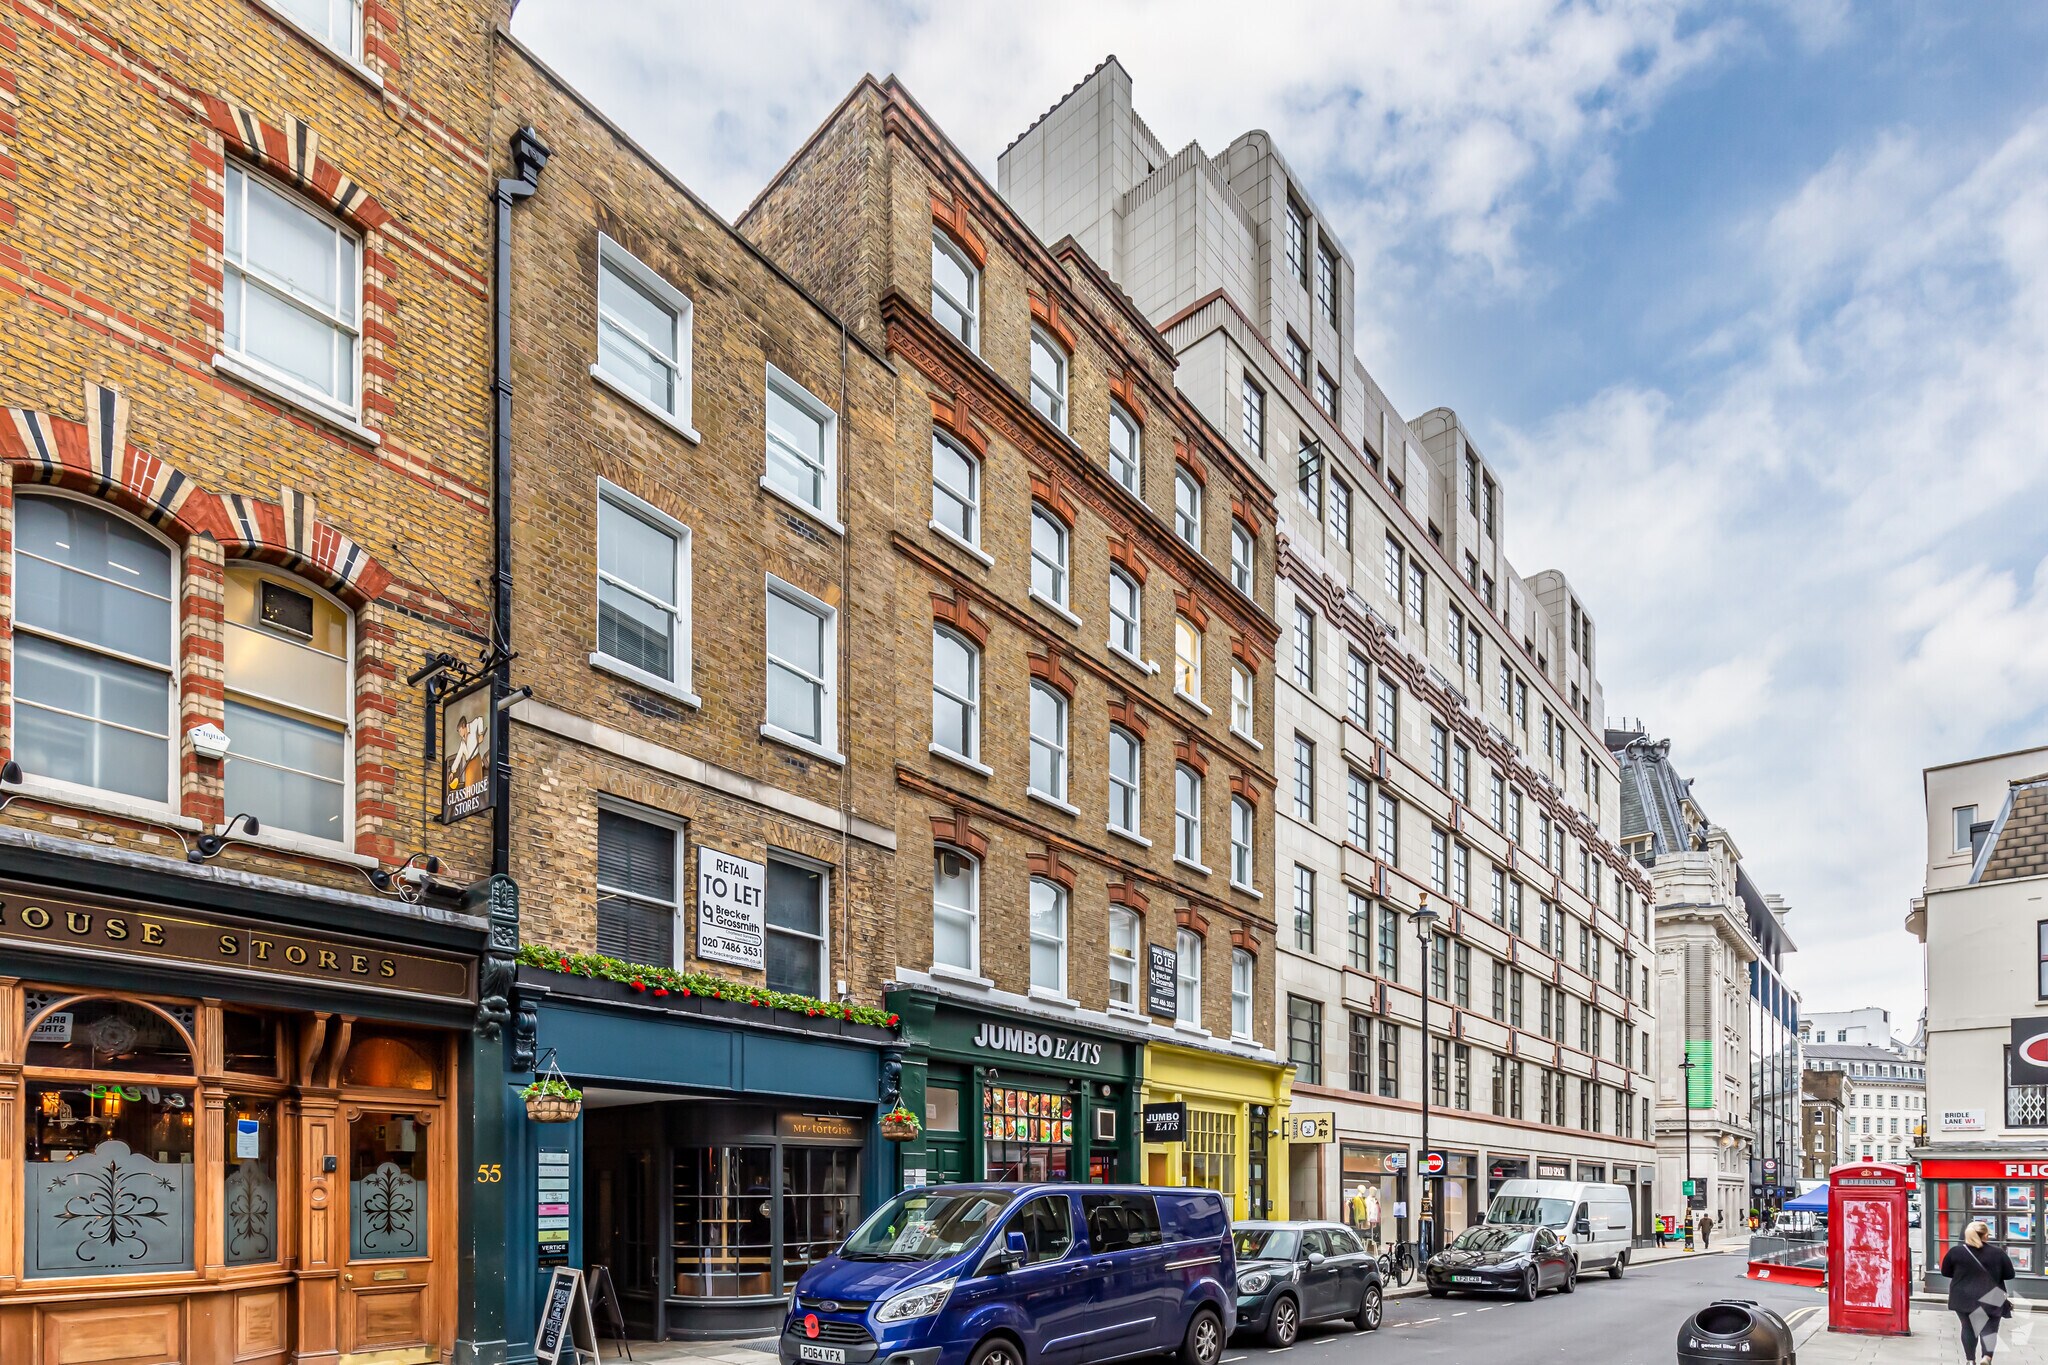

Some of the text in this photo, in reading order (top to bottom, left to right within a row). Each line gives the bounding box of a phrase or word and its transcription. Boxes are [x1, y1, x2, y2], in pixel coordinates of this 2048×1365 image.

[447, 778, 488, 806] GLASSHOUSE
[454, 795, 480, 816] STORES
[716, 858, 750, 880] RETAIL
[703, 873, 762, 907] TO LET
[716, 904, 750, 921] Brecker
[716, 915, 760, 933] Grossmith
[0, 902, 397, 977] OUSE STORES
[702, 936, 718, 948] 020
[721, 940, 741, 953] 7486
[743, 945, 762, 958] 3531
[1152, 953, 1175, 969] TO LET
[973, 1023, 1102, 1065] JUMBO EATS
[1146, 1112, 1180, 1122] JUMBO
[1155, 1122, 1179, 1132] EATS
[1318, 1117, 1329, 1140] 太郎
[477, 1164, 502, 1183] 55
[803, 1346, 841, 1362] PO64 VFX
[1700, 1342, 1722, 1350] general
